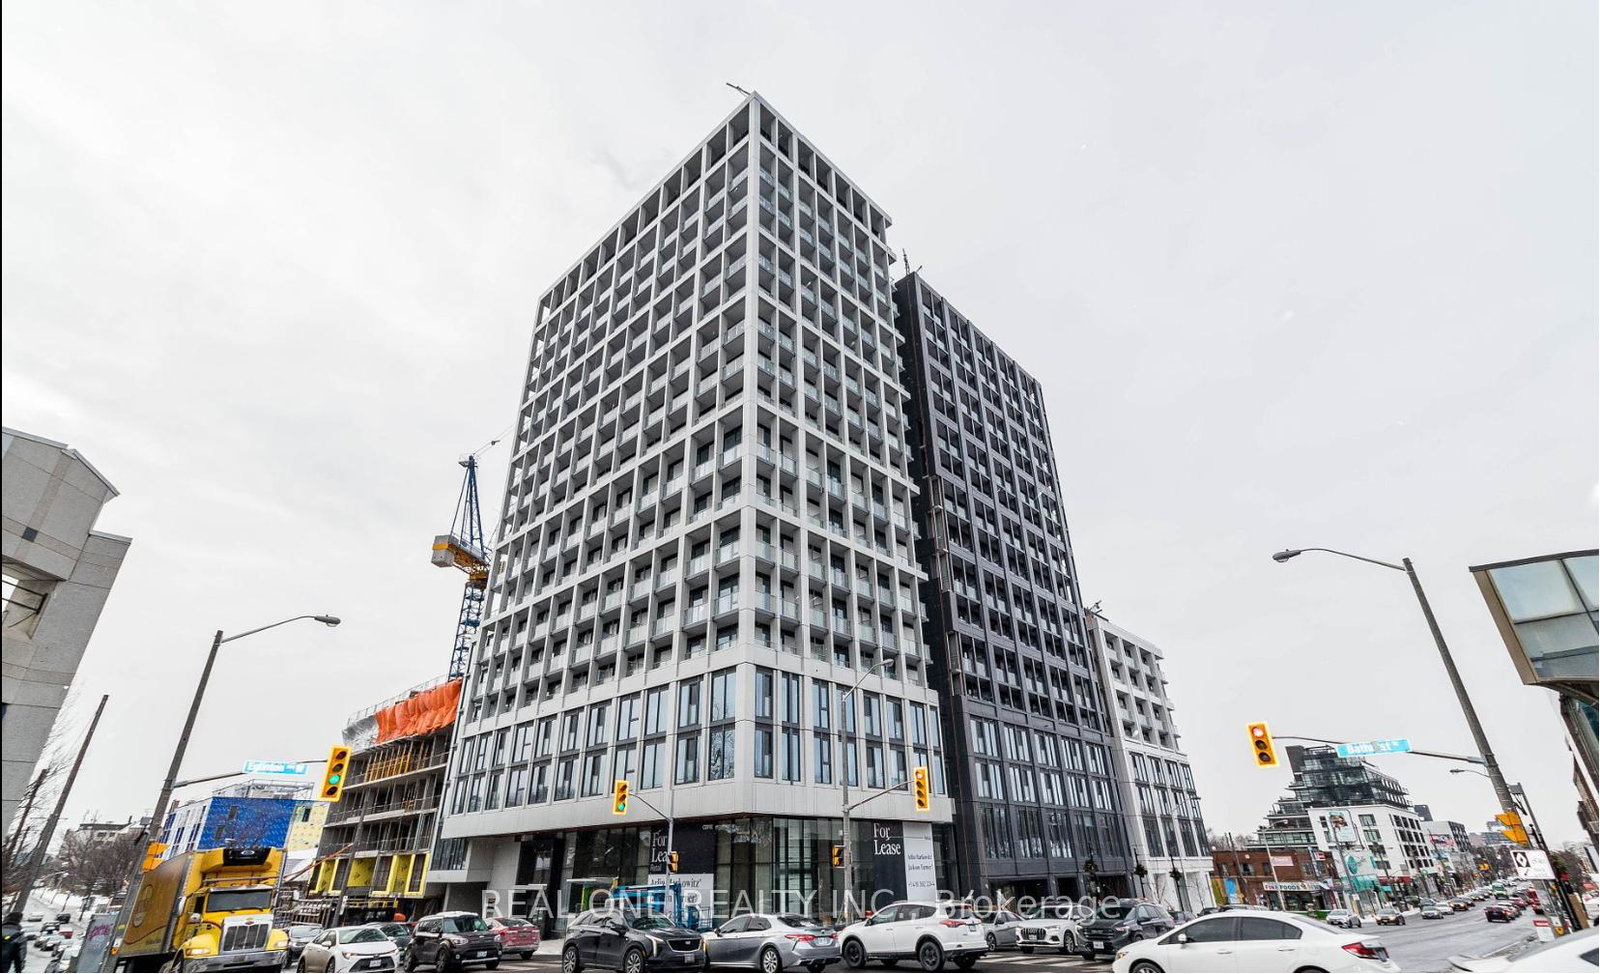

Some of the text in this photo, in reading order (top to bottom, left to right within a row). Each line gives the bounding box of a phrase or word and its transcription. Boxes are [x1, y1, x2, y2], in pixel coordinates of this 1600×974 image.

[1347, 742, 1392, 755] Bathust
[652, 830, 667, 847] For
[873, 823, 890, 839] For
[651, 847, 668, 863] Lea
[874, 839, 901, 855] Lease
